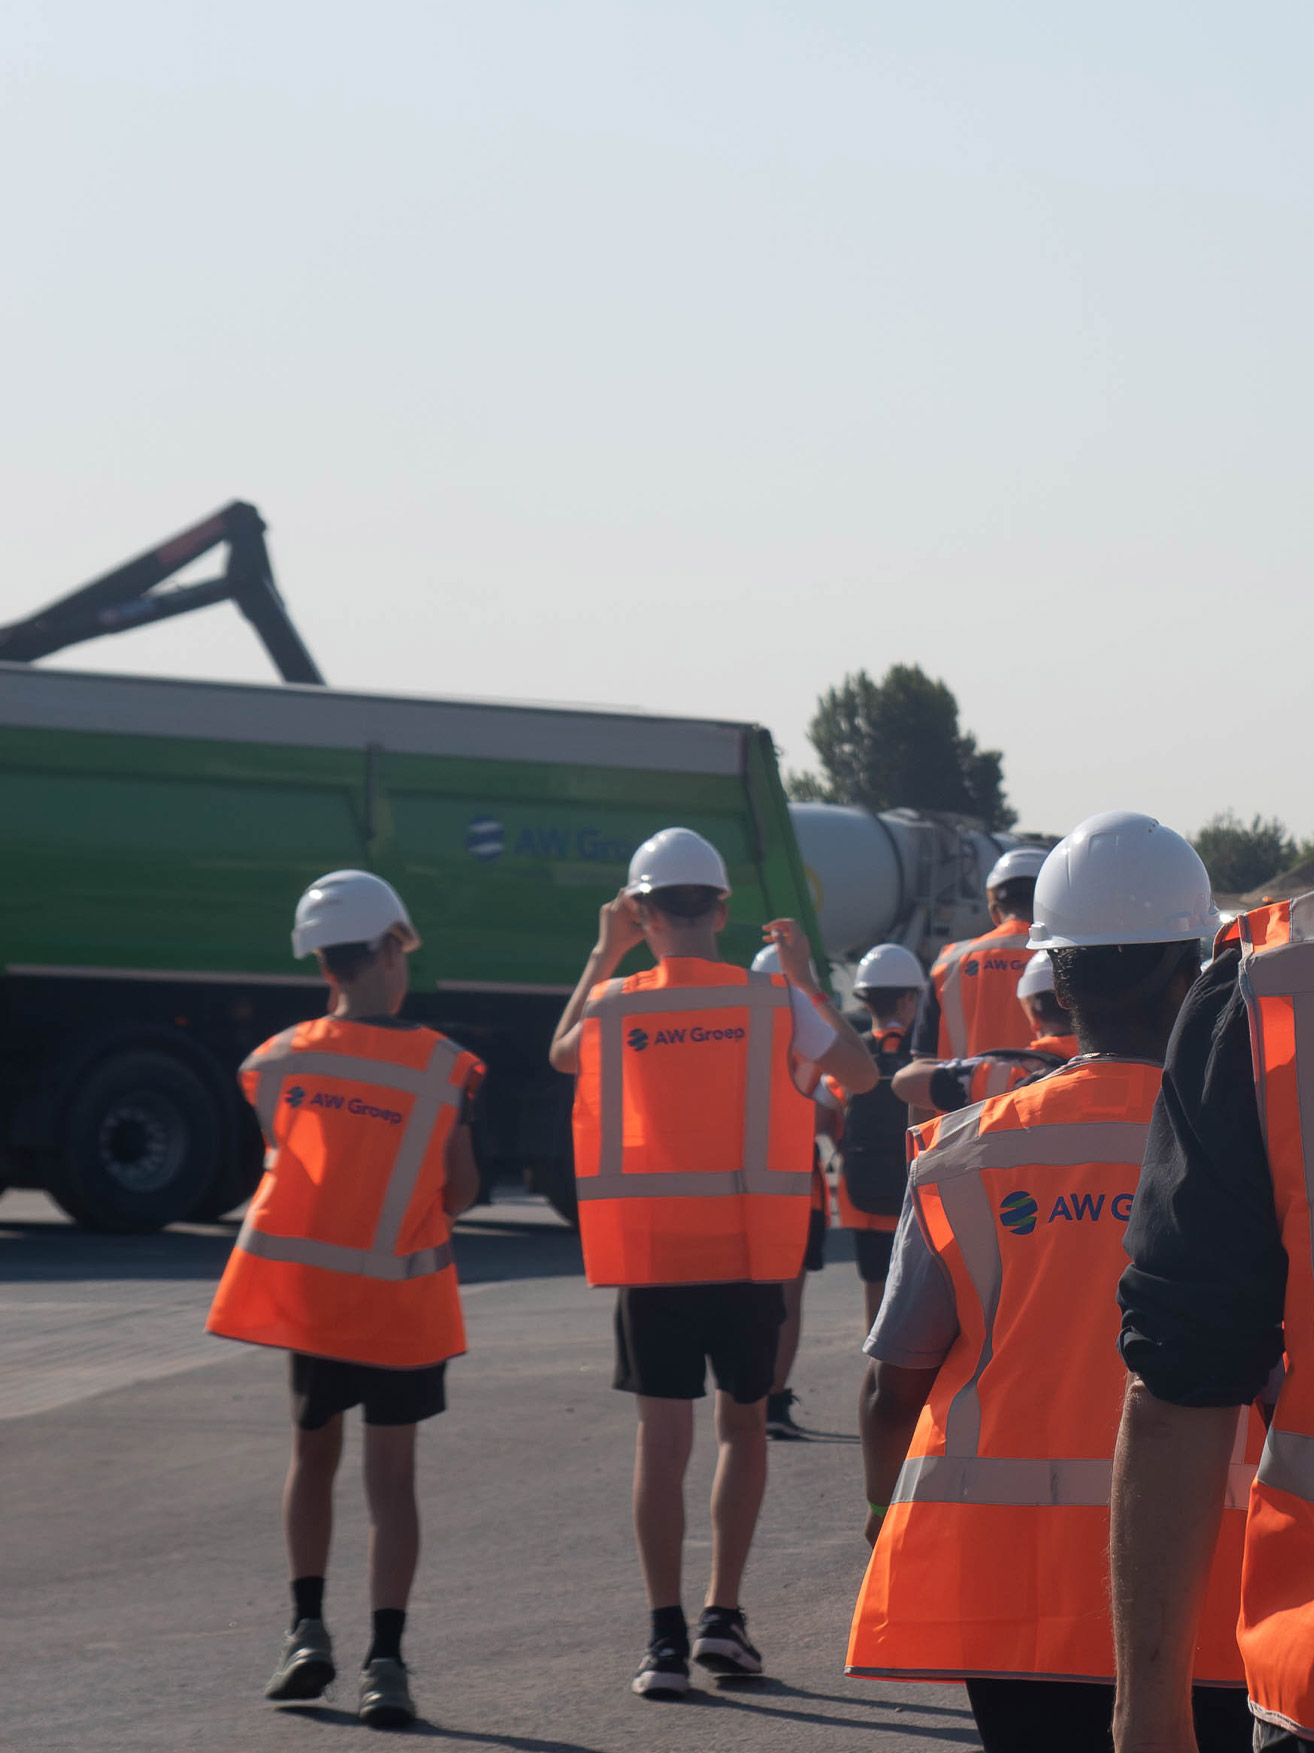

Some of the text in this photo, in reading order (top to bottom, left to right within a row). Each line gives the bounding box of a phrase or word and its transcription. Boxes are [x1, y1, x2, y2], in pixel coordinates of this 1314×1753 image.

[514, 826, 569, 859] AW
[984, 959, 1007, 971] AW
[655, 1026, 745, 1045] AW Groep
[310, 1092, 403, 1126] AW Groep
[1048, 1193, 1105, 1223] AW
